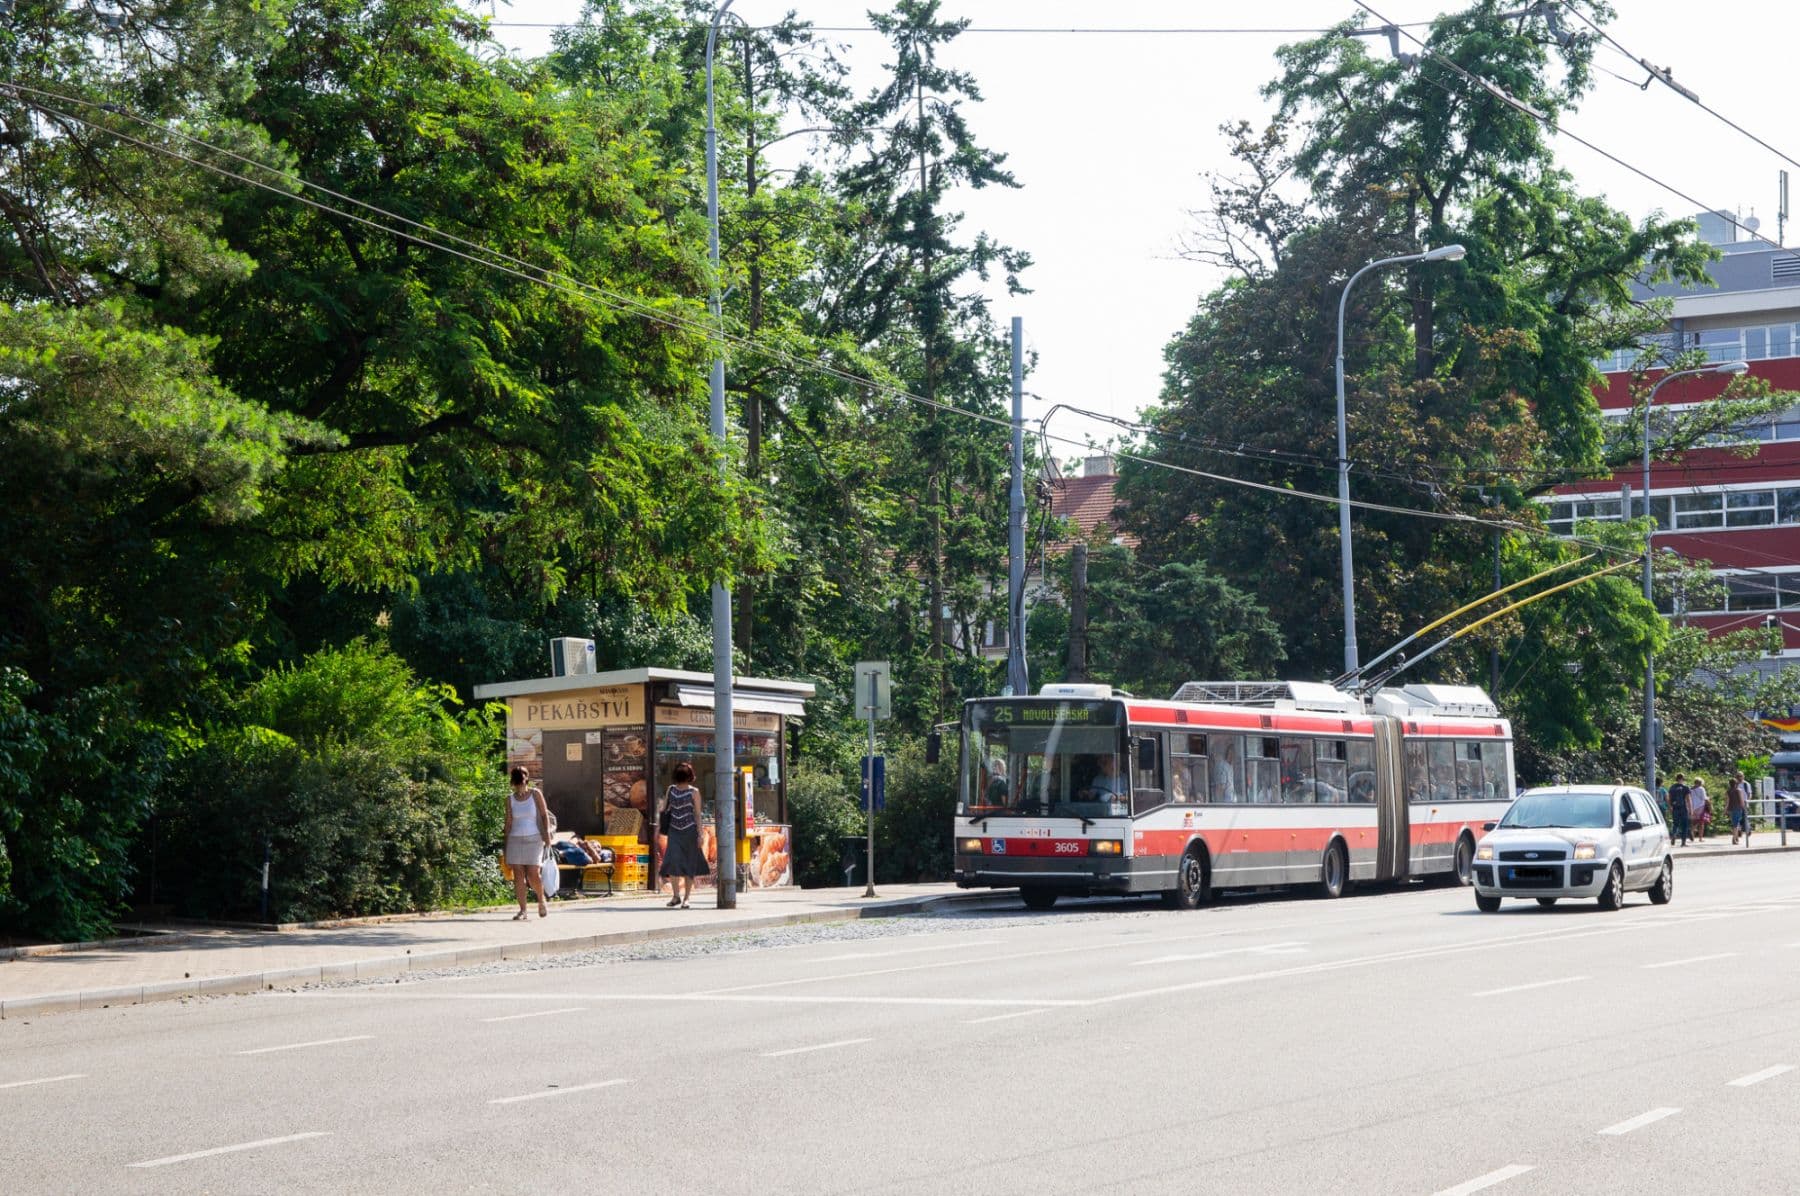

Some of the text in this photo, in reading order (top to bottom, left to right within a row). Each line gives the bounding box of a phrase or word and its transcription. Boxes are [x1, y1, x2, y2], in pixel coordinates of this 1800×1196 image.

[528, 697, 630, 721] PEKAŘSTVÍ
[994, 706, 1012, 722] 25
[1055, 842, 1079, 853] 3605
